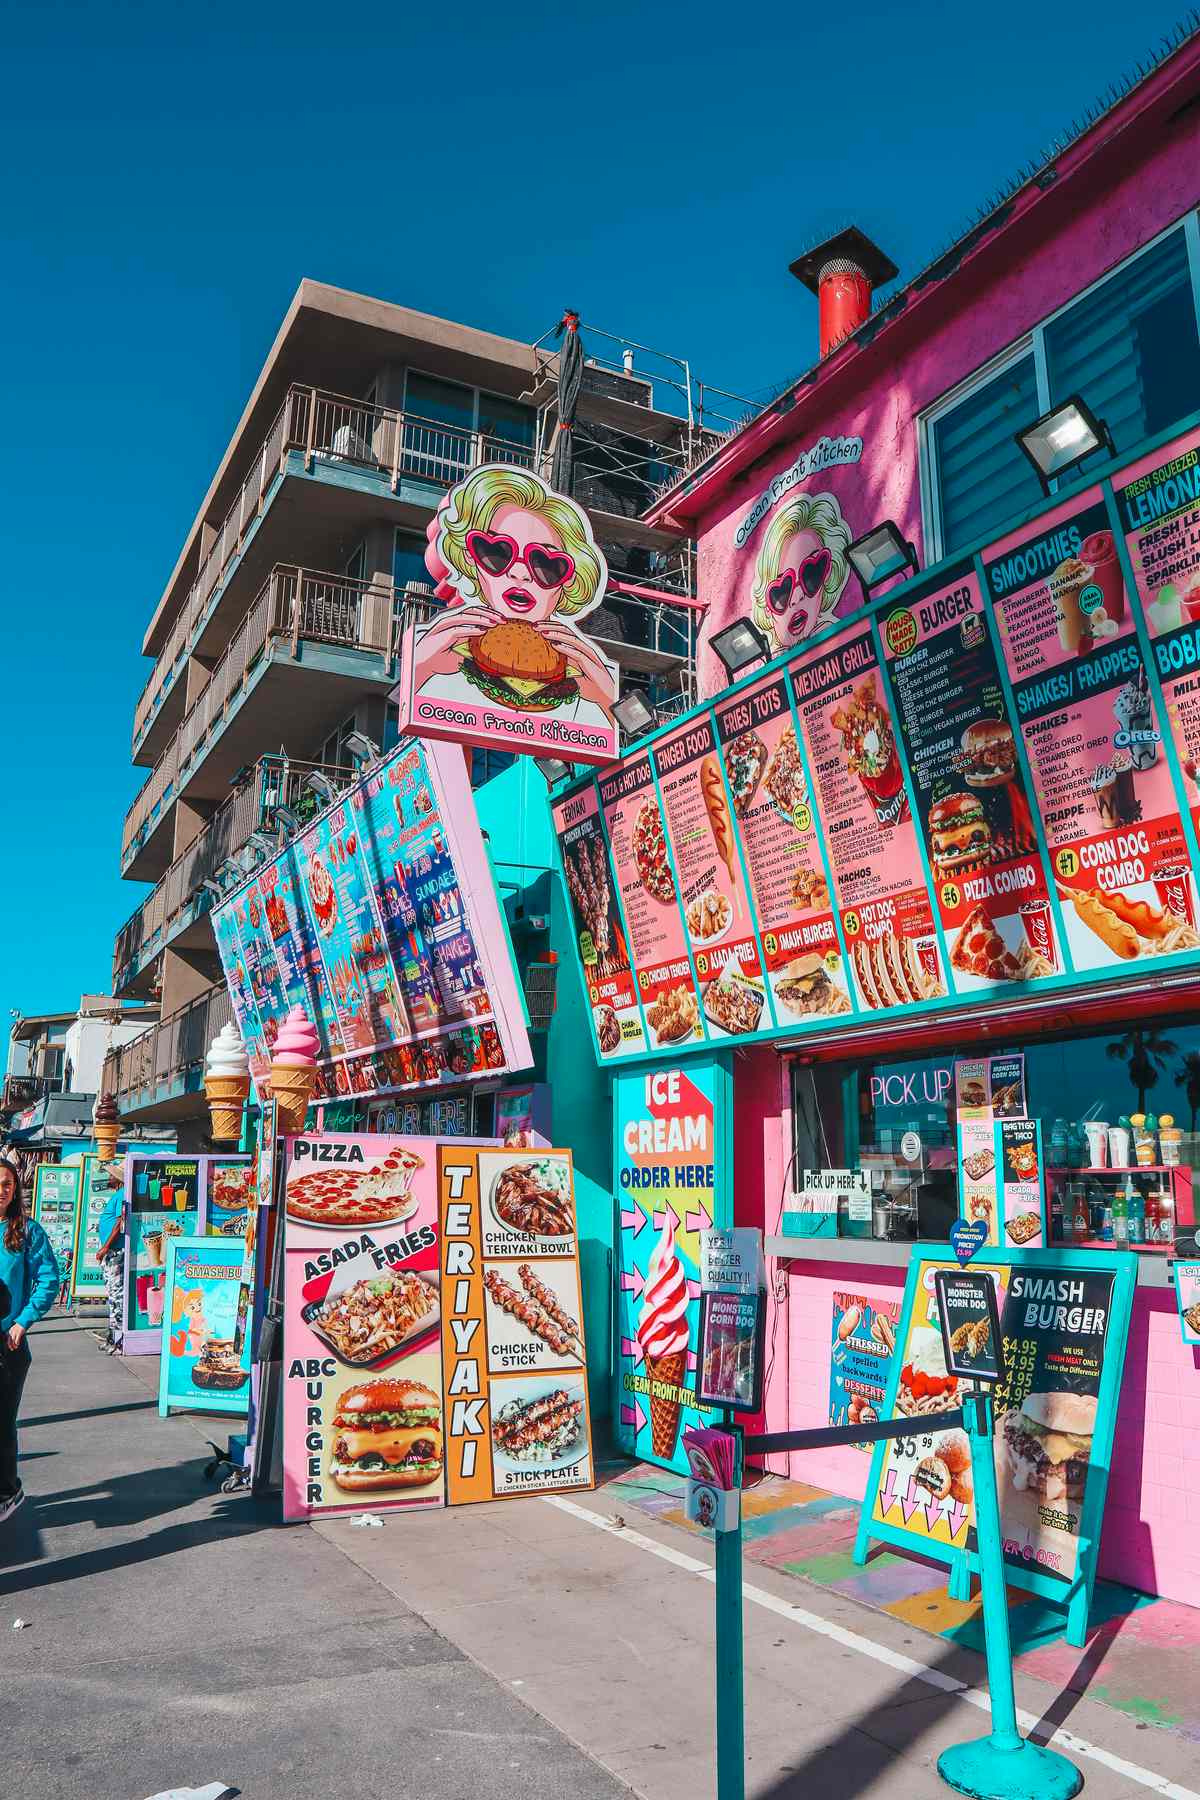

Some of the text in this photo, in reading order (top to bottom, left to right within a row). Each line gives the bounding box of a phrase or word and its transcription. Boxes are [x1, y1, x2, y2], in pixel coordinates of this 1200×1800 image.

[1125, 450, 1198, 501] FRESH SQUEEZED
[736, 442, 858, 544] Ocean Front Kitchen
[1139, 520, 1180, 552] FRESH
[992, 525, 1081, 593] SMOOTHIES
[1142, 540, 1185, 569] SLUSH
[1050, 572, 1082, 590] BANANA
[920, 586, 974, 633] BURGER
[1005, 582, 1080, 623] STRAWBERRY MANGO
[888, 611, 913, 633] HOUSE
[1008, 605, 1058, 633] PEACH MANGO
[1010, 612, 1066, 643] MANGO BANANA
[1012, 628, 1058, 653] STRAWBERRY
[894, 648, 929, 672] BURGER
[929, 648, 954, 665] BURGER
[1014, 648, 1040, 663] MANGO
[1017, 656, 1046, 674] BANANA
[793, 640, 876, 700] MEXICAN GRILL
[899, 665, 949, 692] CLASSIC BURGER
[1076, 649, 1140, 690] FRAPPES
[925, 678, 950, 695] BURGER
[938, 686, 964, 703] BURGER
[754, 688, 781, 718] TOTS
[803, 685, 853, 717] QUESADILLAS
[419, 703, 608, 748] Ocean Front Kitchen
[920, 709, 945, 724] BURGER
[934, 705, 982, 732] VEGAN BURGER
[1025, 714, 1068, 739] SHAKES
[657, 728, 711, 771] FINGER FOOD
[914, 737, 955, 762] CHICKEN
[1032, 733, 1053, 746] OREO
[1035, 734, 1082, 757] CHOCO OREO
[1113, 730, 1161, 749] OREO
[1037, 736, 1108, 767] STRAWBERRY OREO
[815, 757, 840, 775] TACOS
[917, 758, 936, 771] CRISPY
[920, 758, 972, 783] BUFFALO CHICKEN
[1039, 762, 1069, 777] VANILLA
[601, 763, 650, 803] PIZZA HOT DOG
[678, 771, 698, 787] SNACK
[1041, 767, 1084, 787] CHOCOLATE
[1043, 775, 1092, 798] STRAWBERRY
[561, 797, 586, 823] TERIYAKI
[1046, 795, 1071, 808] FRUITY
[829, 818, 854, 834] ASADA
[1044, 804, 1085, 826] FRAPPE
[564, 827, 581, 846] CHICKEN
[1052, 821, 1078, 834] MOCHA
[1054, 829, 1088, 845] CARAMEL
[1058, 831, 1149, 873] #7 CORN DOG
[415, 869, 457, 901] SUNDAES
[838, 867, 872, 885] NACHOS
[943, 864, 1036, 905] #6 PIZZA COMBO
[1096, 860, 1145, 890] COMBO
[866, 886, 889, 898] CHICKEN
[859, 903, 877, 924] HOT
[876, 899, 896, 920] DOG
[779, 920, 836, 951] SMASH BURGER
[864, 919, 894, 941] COMBO
[433, 935, 471, 960] SHAKES
[735, 941, 756, 962] FRIES
[649, 967, 671, 984] CHICKEN
[645, 1069, 681, 1107] ICE
[870, 1070, 951, 1105] PICK UP
[624, 1114, 707, 1154] CREAM
[1014, 1131, 1033, 1140] TACO
[293, 1140, 364, 1163] PIZZA
[620, 1165, 714, 1188] ORDER HERE
[806, 1175, 855, 1189] PICK UP HERE
[485, 1232, 536, 1242] CHICKEN
[304, 1226, 435, 1281] ASADA FRIES
[487, 1242, 573, 1255] TERIYAKI BOWL
[187, 1266, 224, 1278] SMASH
[708, 1270, 744, 1284] QUALITY
[947, 1288, 984, 1299] MONSTER
[1011, 1277, 1084, 1304] SMASH
[712, 1302, 753, 1315] MONSTER
[947, 1298, 968, 1308] CORN
[444, 1166, 487, 1478] TERIYAKI
[709, 1314, 755, 1328] CORN DOG
[1024, 1303, 1105, 1335] BURGER
[491, 1343, 544, 1355] CHICKEN
[846, 1337, 888, 1357] STRESSED
[1003, 1336, 1037, 1355] $4.95
[288, 1359, 337, 1378] ABC
[501, 1355, 537, 1366] STICK
[852, 1356, 879, 1368] spelled
[1066, 1356, 1082, 1364] MEAT
[842, 1366, 882, 1382] backwards
[623, 1374, 678, 1402] OCEAN FRONT
[844, 1379, 886, 1401] DESSERTS
[505, 1466, 579, 1483] STICK PLATE
